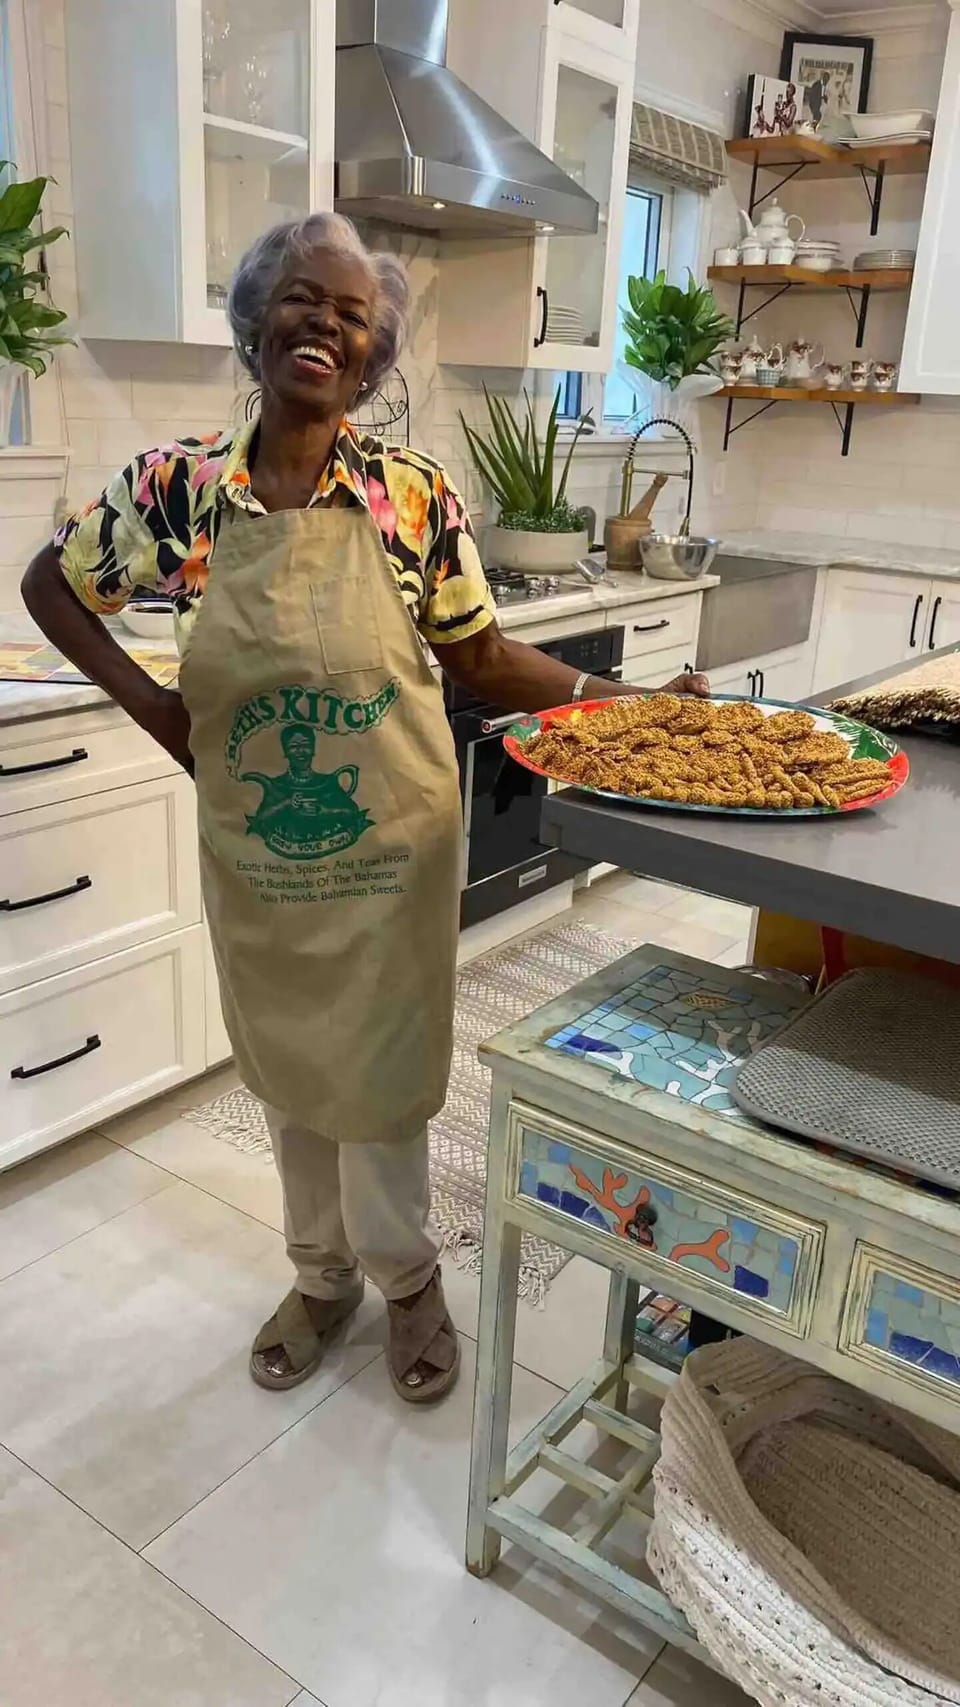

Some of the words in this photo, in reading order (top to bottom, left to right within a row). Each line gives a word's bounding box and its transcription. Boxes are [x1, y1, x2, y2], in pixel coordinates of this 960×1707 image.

[228, 696, 277, 760] BETH'S
[279, 683, 397, 729] KITCHEN
[236, 860, 261, 873] Exotic
[333, 860, 354, 871] And
[383, 854, 409, 865] From
[248, 876, 265, 889] The
[266, 878, 314, 890] Bushlands
[316, 876, 329, 888] Of
[333, 873, 351, 885] The
[354, 871, 398, 882] Bahamas
[280, 891, 317, 905] Provide
[320, 887, 368, 901] Bahamian
